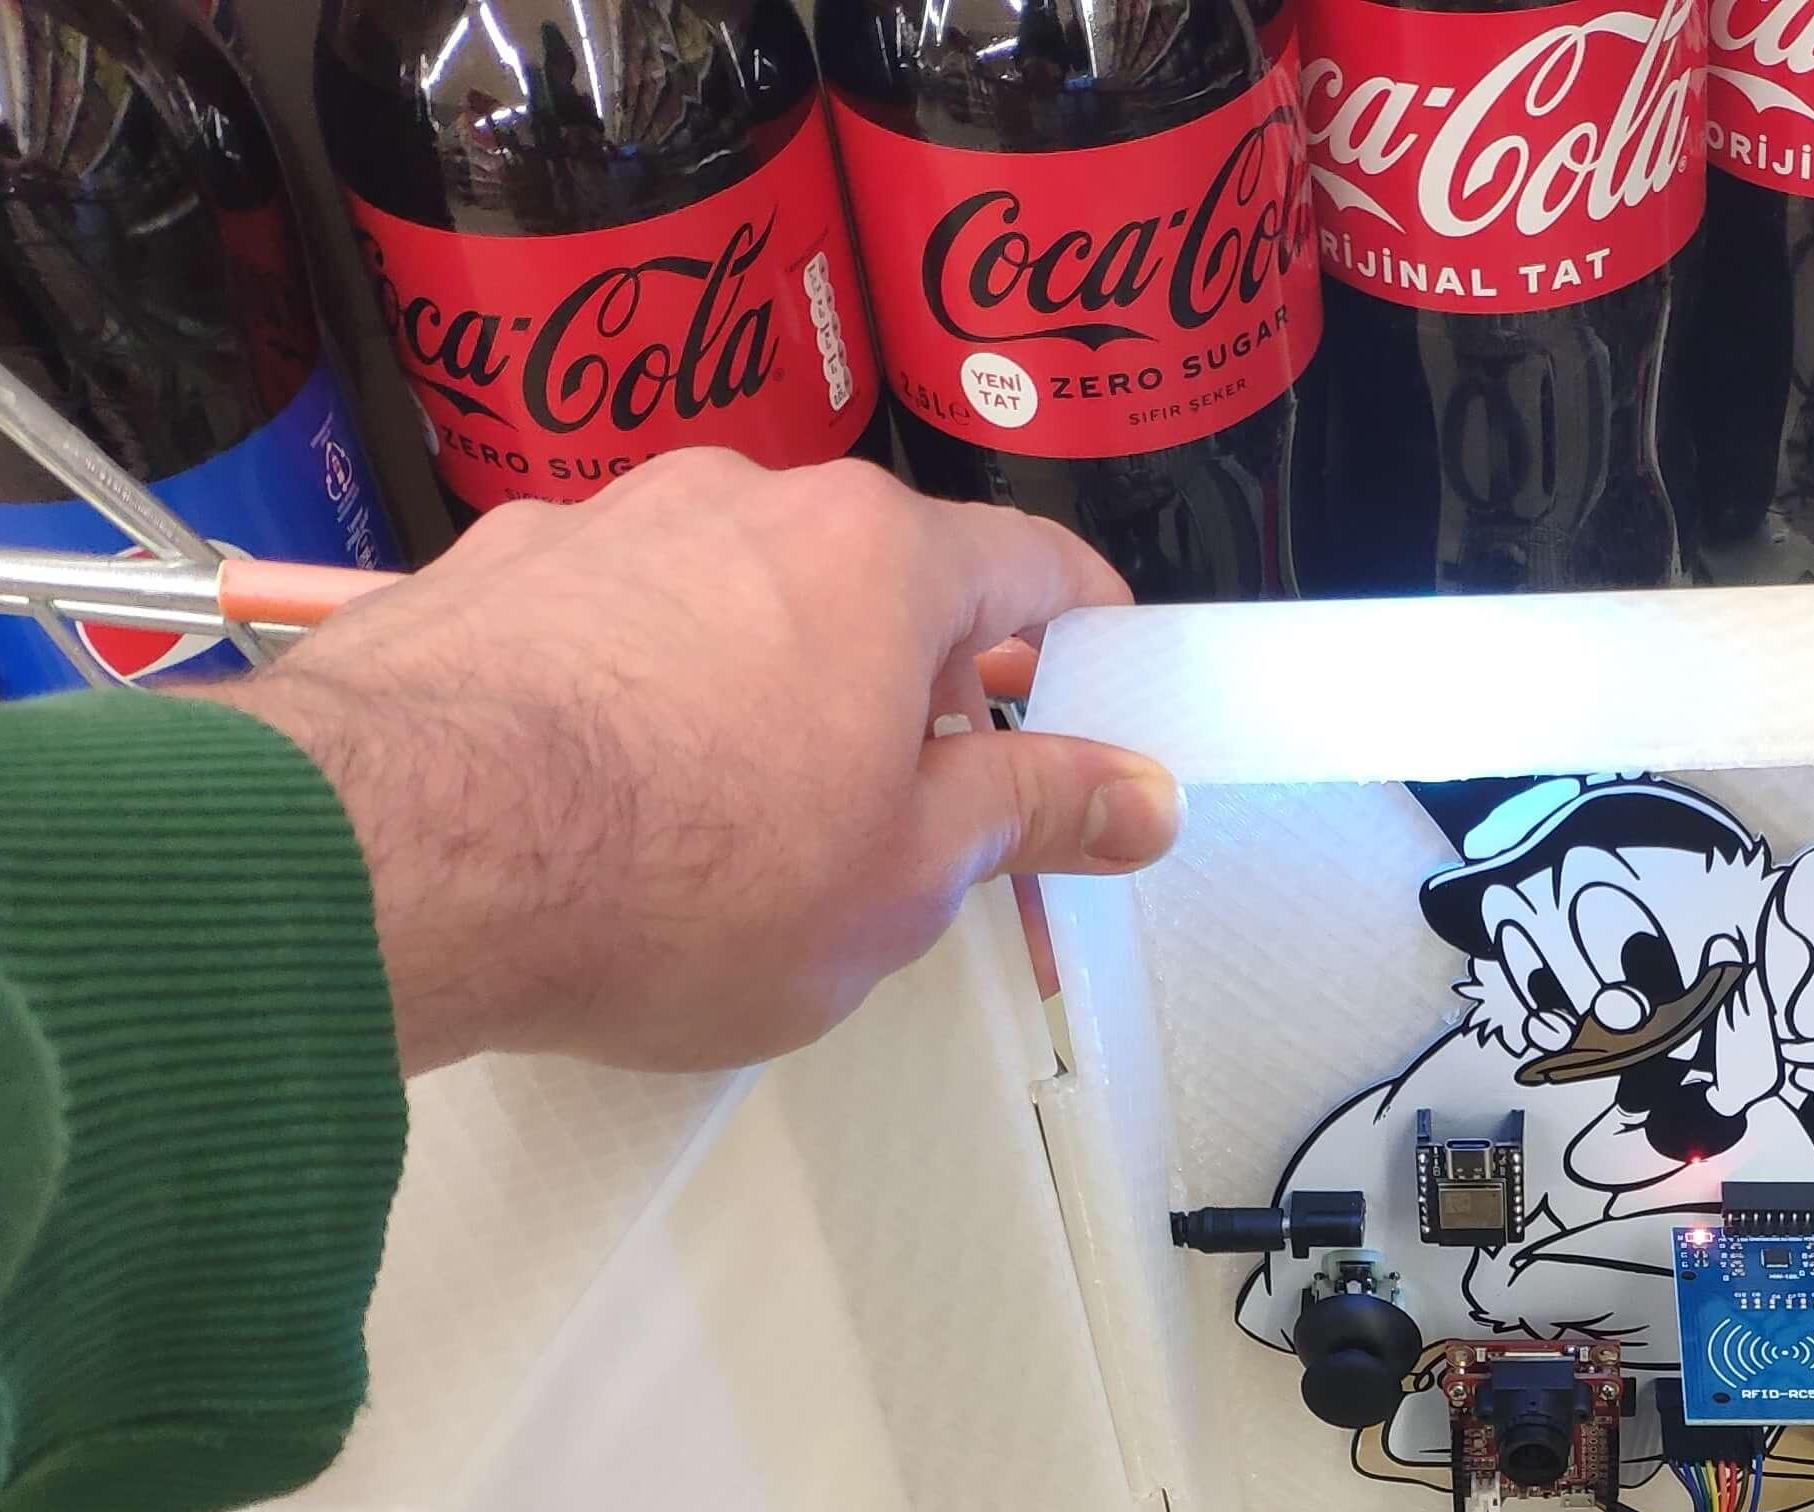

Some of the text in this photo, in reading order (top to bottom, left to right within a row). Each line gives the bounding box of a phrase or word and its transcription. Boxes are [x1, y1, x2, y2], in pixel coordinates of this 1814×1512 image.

[1303, 0, 1690, 238] ca-Cola
[1318, 227, 1611, 298] RİJİNAL TAT
[358, 203, 780, 435] ca-Cola
[969, 368, 1023, 392] YENİ
[1049, 304, 1290, 400] ZERO SUGAR
[978, 388, 1021, 411] TAT
[1128, 405, 1181, 426] SIFIR
[442, 424, 632, 481] ZERO SUG
